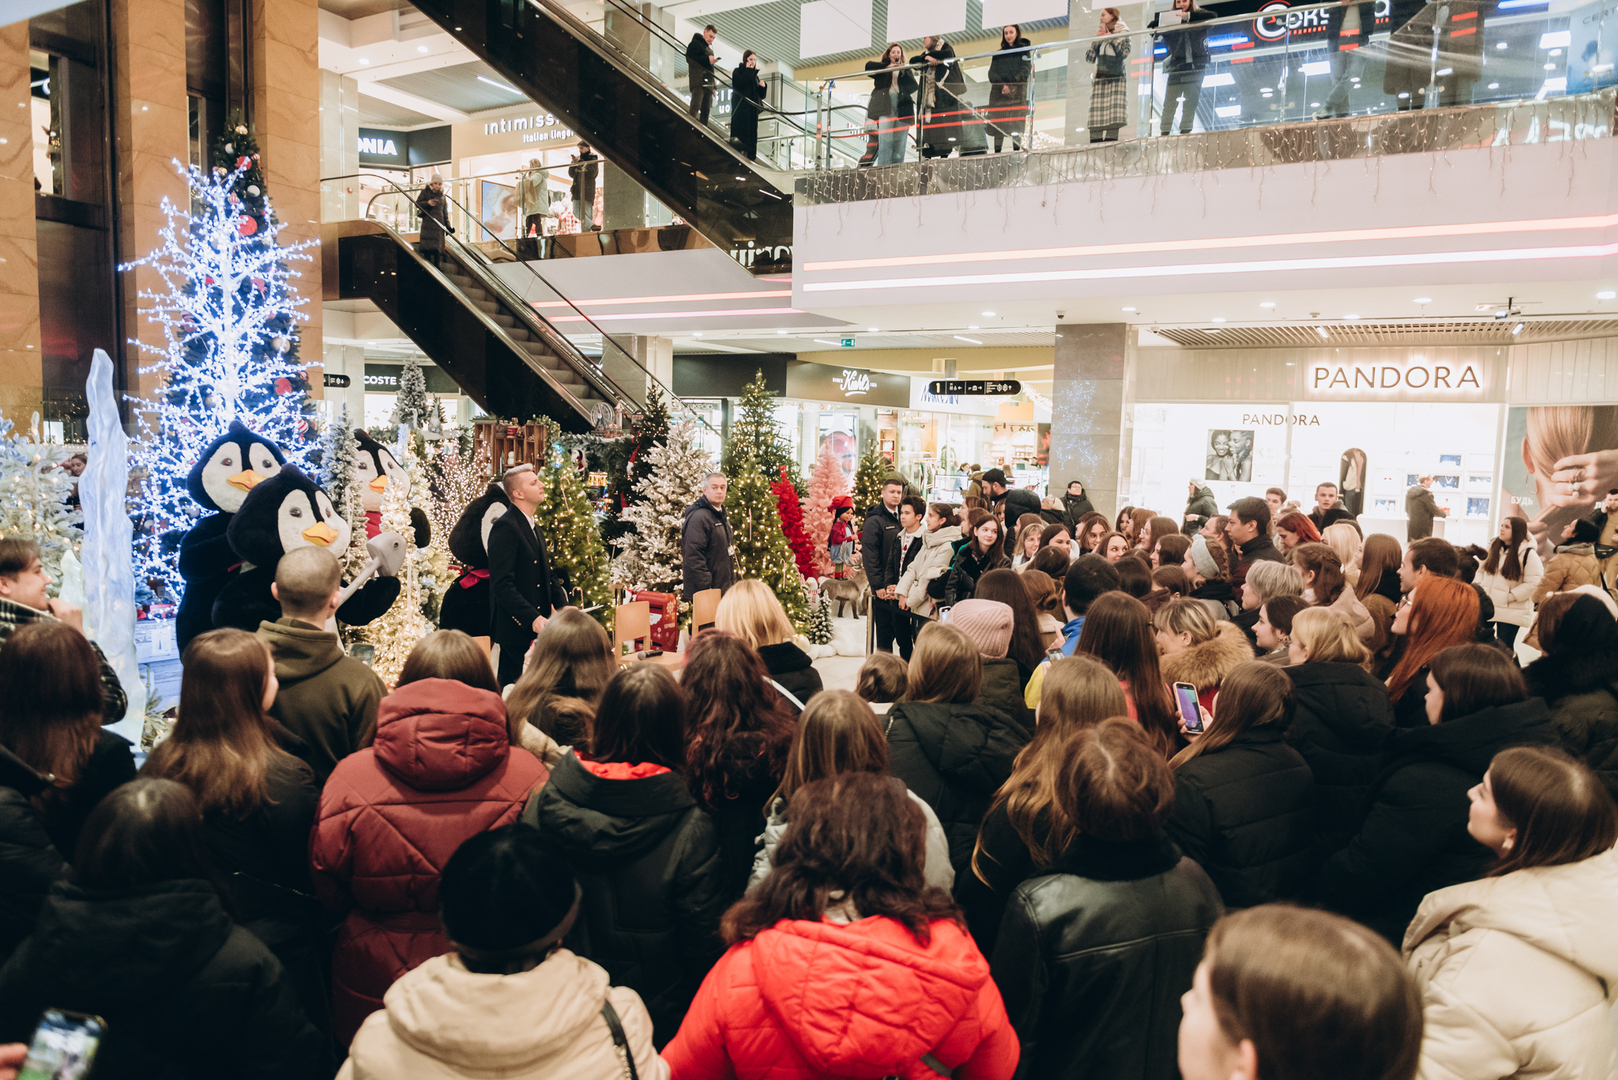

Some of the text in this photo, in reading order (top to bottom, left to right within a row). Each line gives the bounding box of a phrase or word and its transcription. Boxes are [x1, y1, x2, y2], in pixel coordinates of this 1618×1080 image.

[523, 132, 549, 143] Italian
[364, 375, 397, 386] COSTE
[1313, 365, 1481, 389] PANDORA
[935, 382, 941, 394] 1
[1242, 413, 1321, 426] PANDORA
[1510, 496, 1534, 506] БУДЬ
